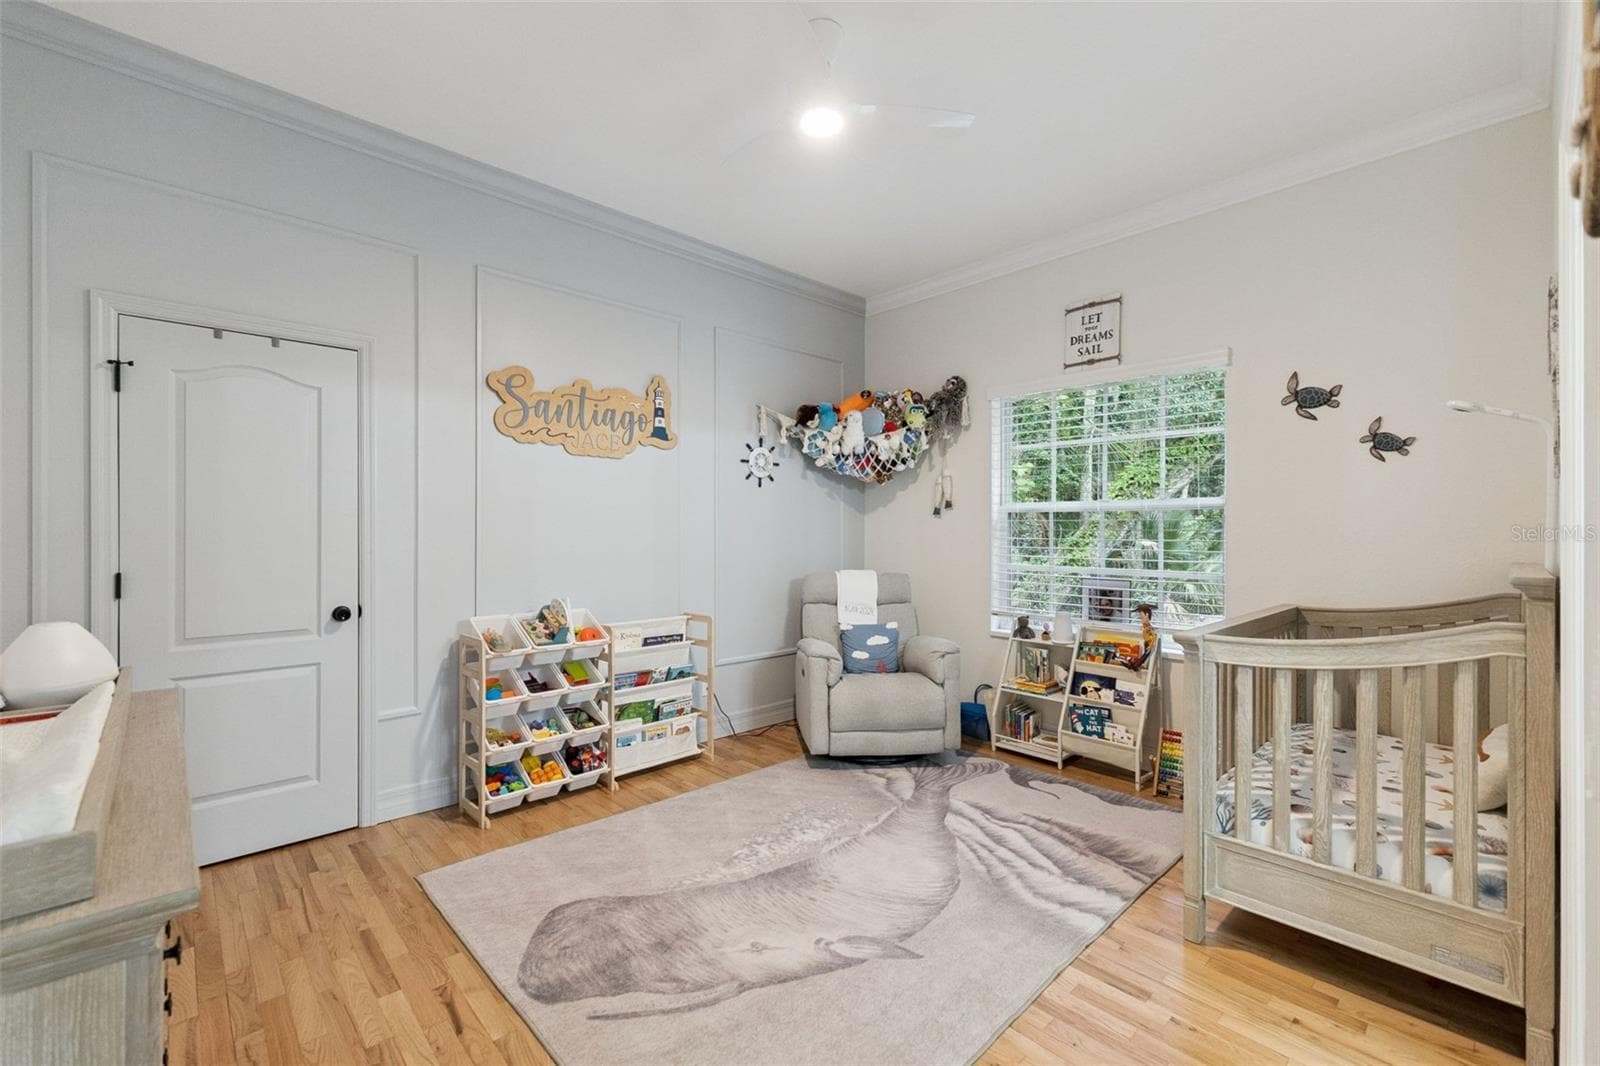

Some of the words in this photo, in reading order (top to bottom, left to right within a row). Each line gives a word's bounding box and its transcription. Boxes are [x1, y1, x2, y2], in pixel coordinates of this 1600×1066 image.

[1081, 312, 1103, 326] LET
[1070, 329, 1114, 346] DREAMS
[1077, 344, 1103, 357] SAIL
[497, 373, 652, 446] Santiago
[571, 430, 621, 451] JACE
[1084, 708, 1099, 716] CAT
